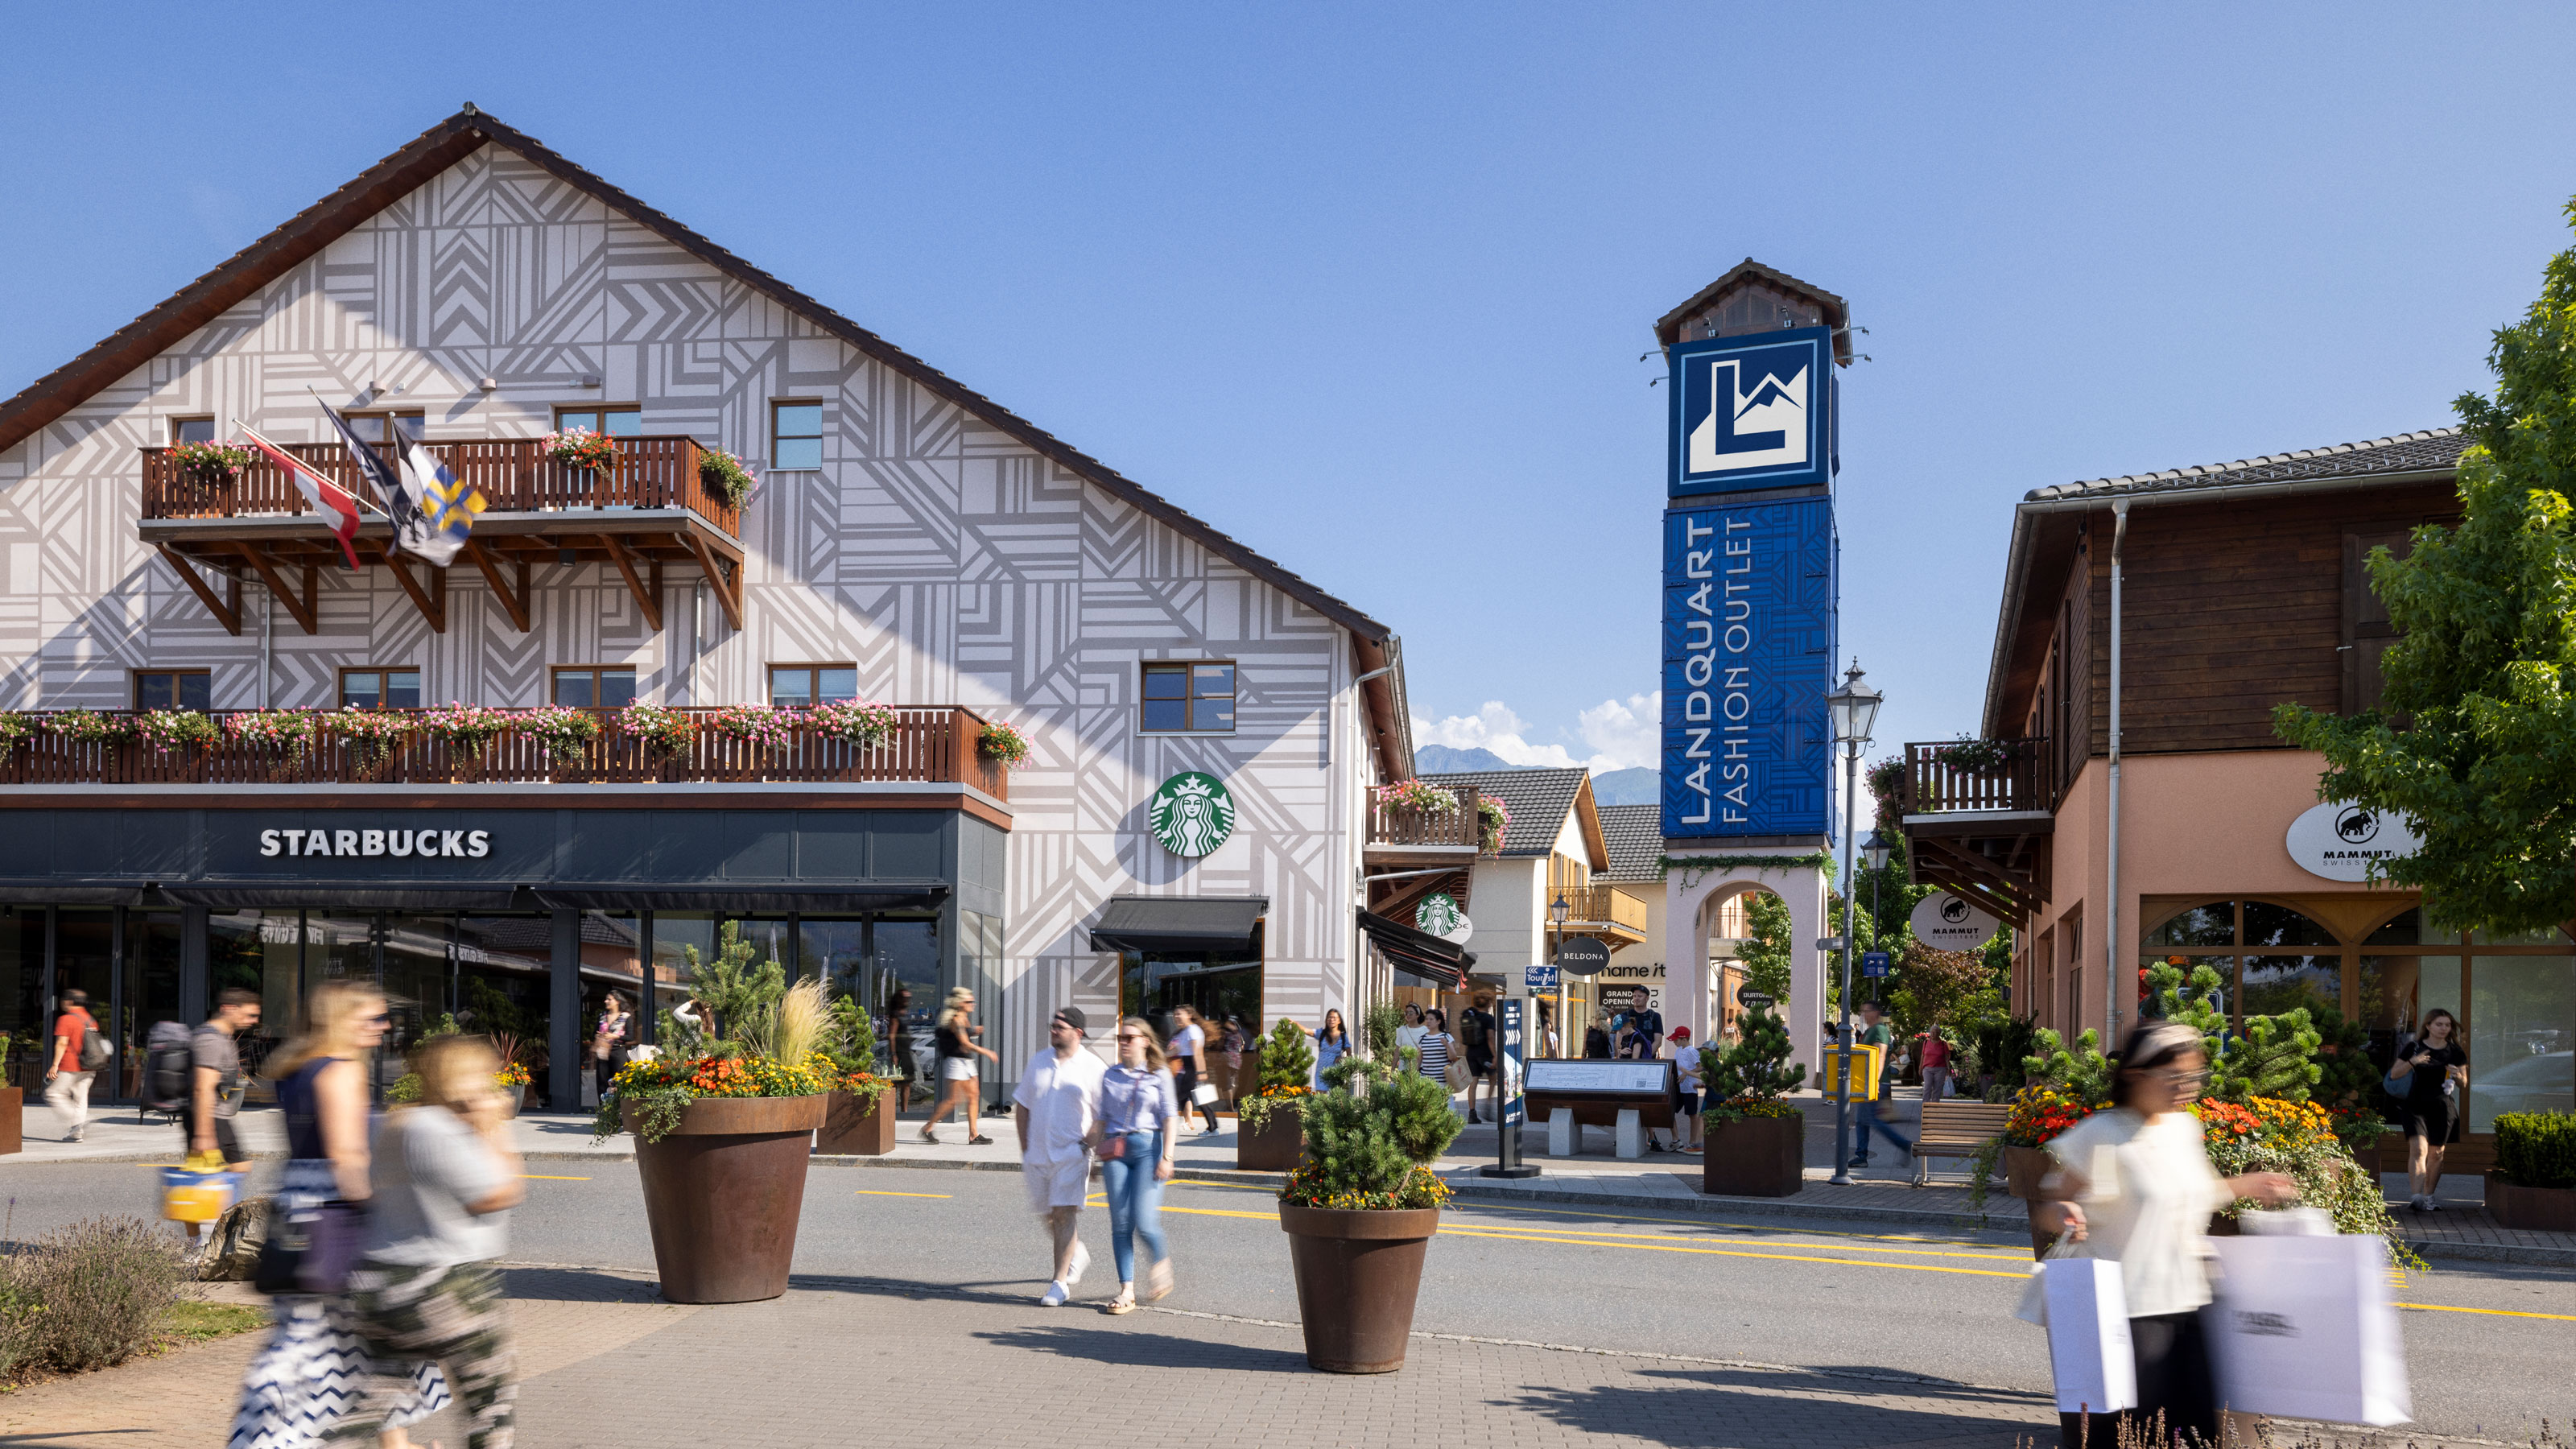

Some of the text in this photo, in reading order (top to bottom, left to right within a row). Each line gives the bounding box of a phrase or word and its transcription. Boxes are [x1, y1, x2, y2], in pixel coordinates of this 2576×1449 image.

[1682, 518, 1716, 824] LANDQUART
[1724, 518, 1751, 823] FASHION OUTLET
[260, 829, 489, 857] STARBUCKS
[2323, 850, 2392, 859] MAMMUT
[1527, 968, 1554, 986] Tourist
[1601, 963, 1666, 977] name it
